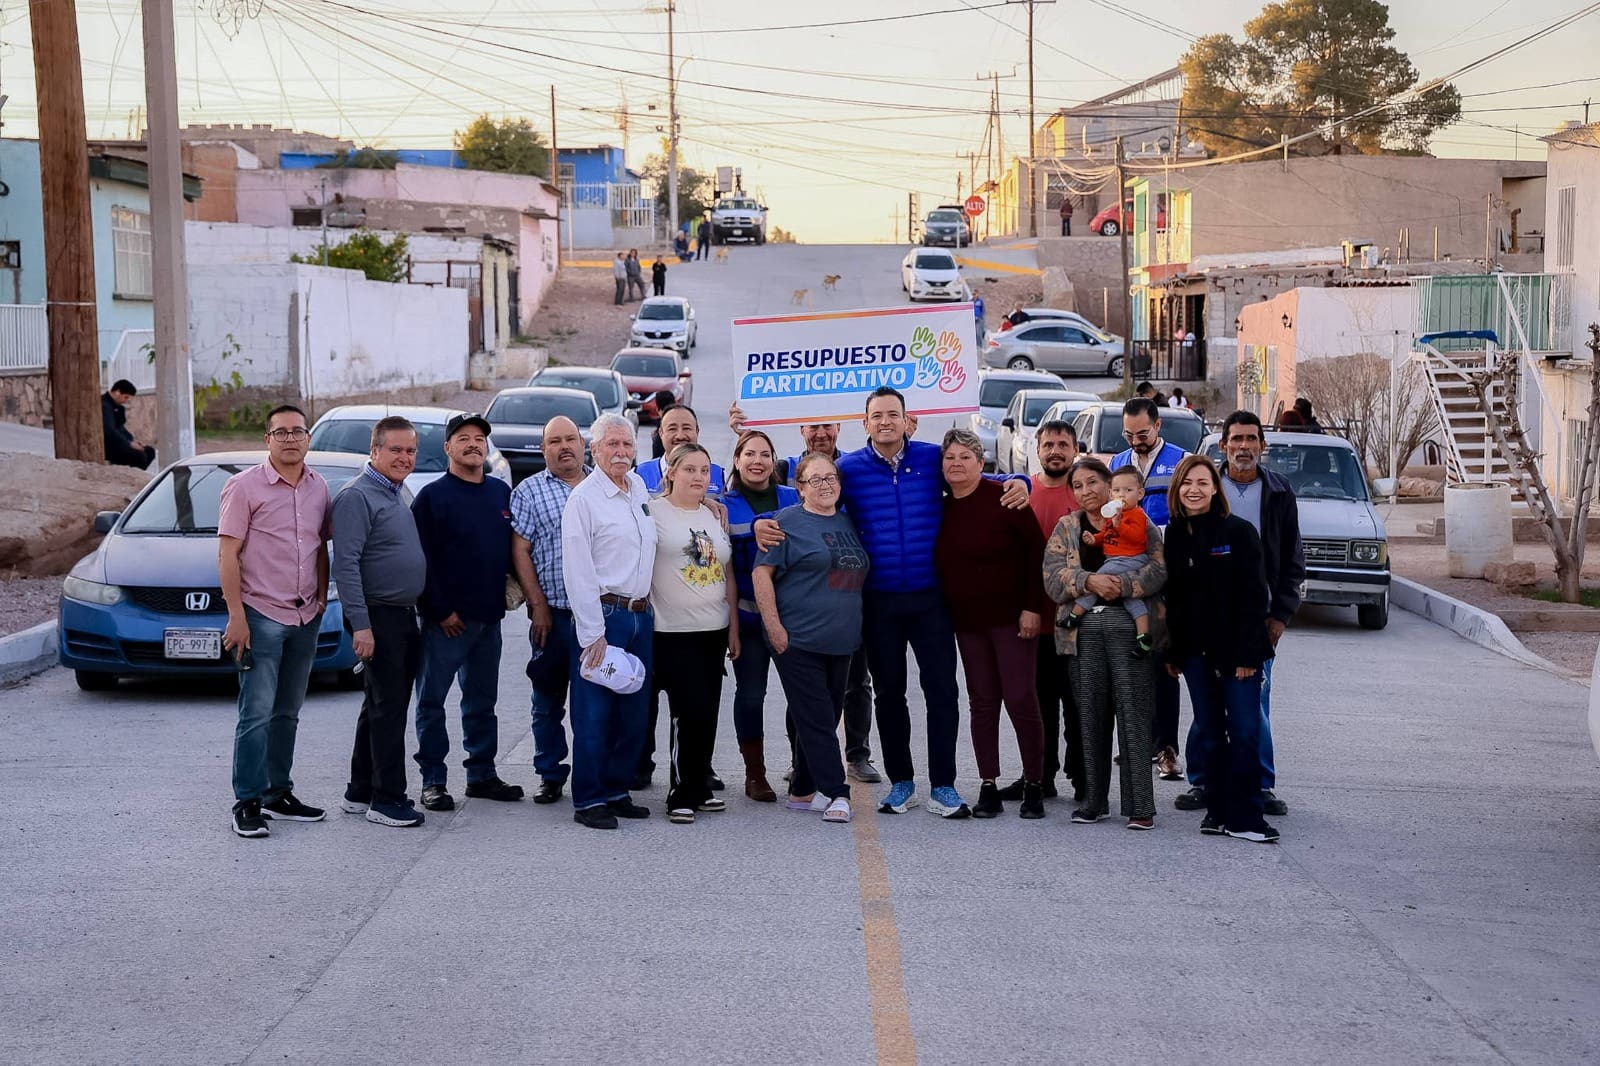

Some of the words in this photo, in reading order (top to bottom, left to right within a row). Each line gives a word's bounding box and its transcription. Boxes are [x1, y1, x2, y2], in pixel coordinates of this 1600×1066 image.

[966, 202, 984, 210] ALTO
[747, 343, 906, 371] PRESUPUESTO
[751, 367, 906, 395] PARTICIPATIVO
